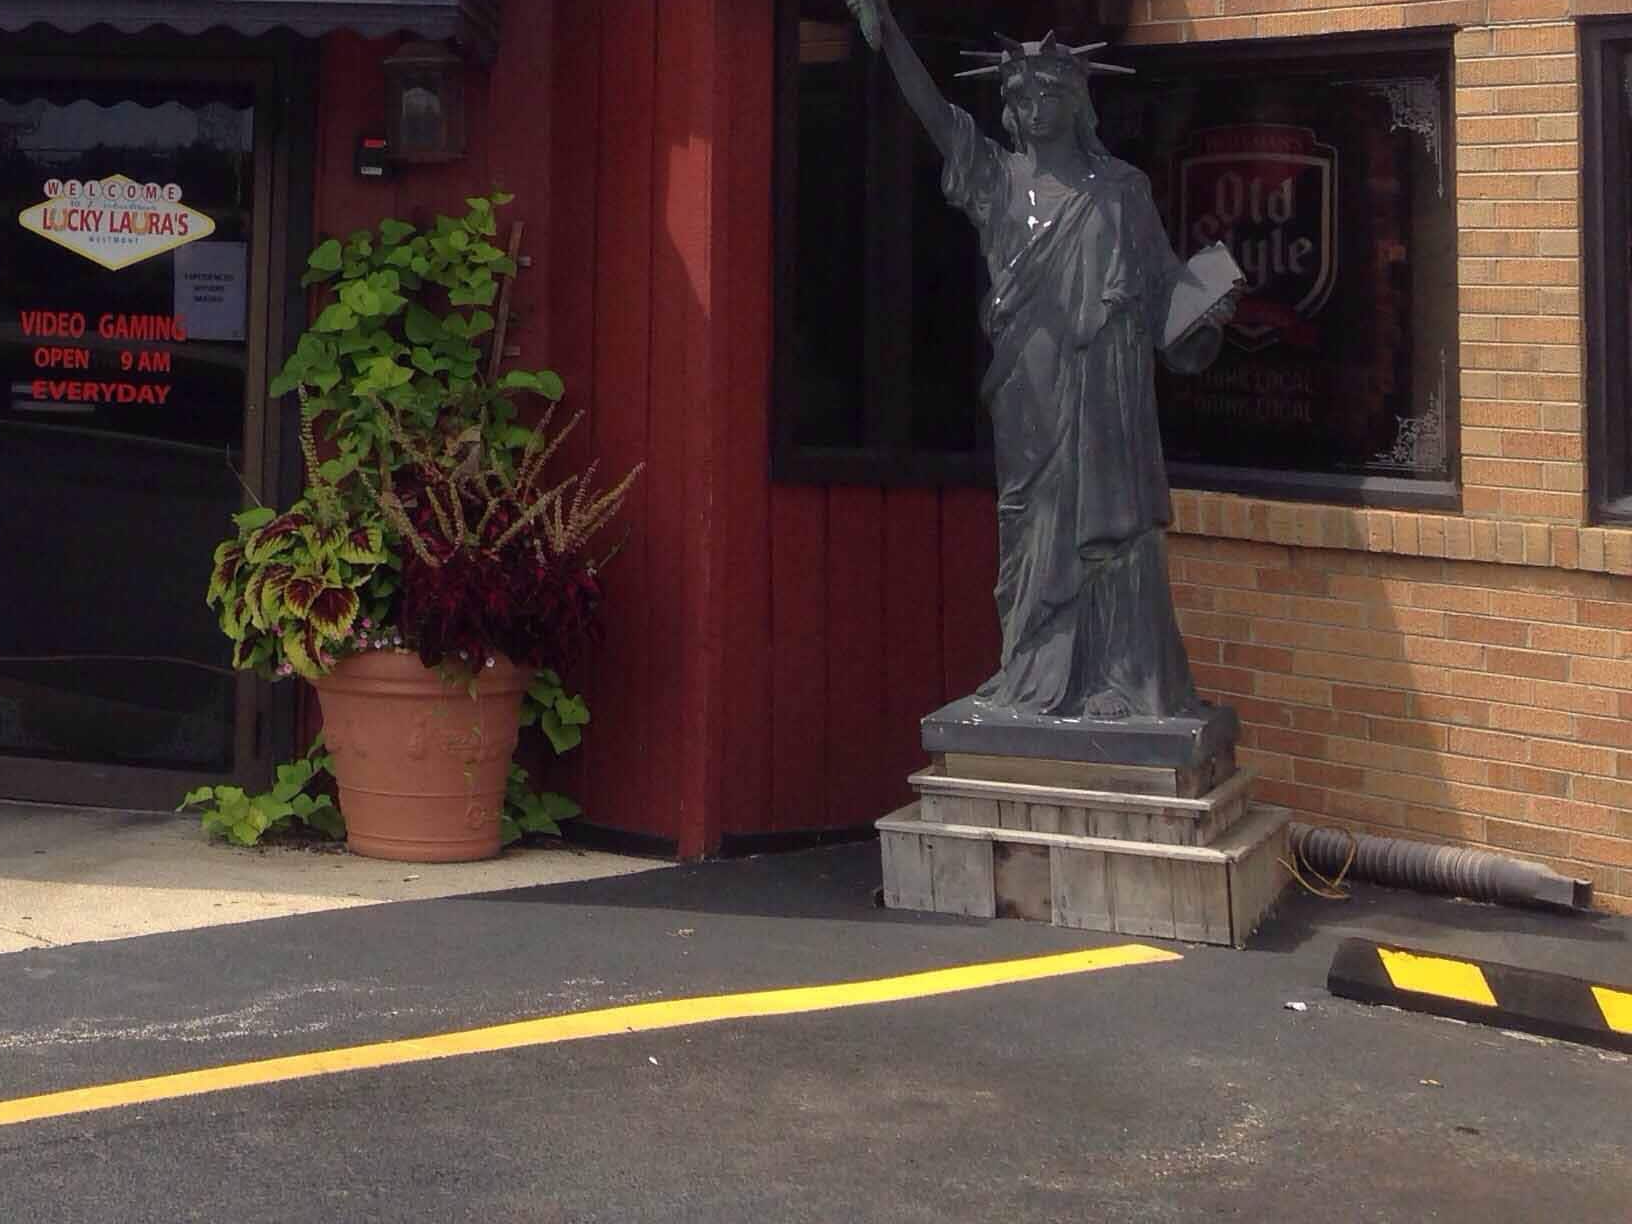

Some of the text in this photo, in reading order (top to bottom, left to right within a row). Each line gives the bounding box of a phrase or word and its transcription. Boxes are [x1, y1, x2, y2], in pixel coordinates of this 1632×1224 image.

[45, 179, 180, 202] WELCOME
[1216, 170, 1294, 225] Old
[42, 207, 189, 236] LUCKY LAURA'S
[20, 311, 188, 342] VIDEO GAMING
[34, 347, 171, 373] OPEN 9 AM
[31, 380, 172, 405] EVERYDAY
